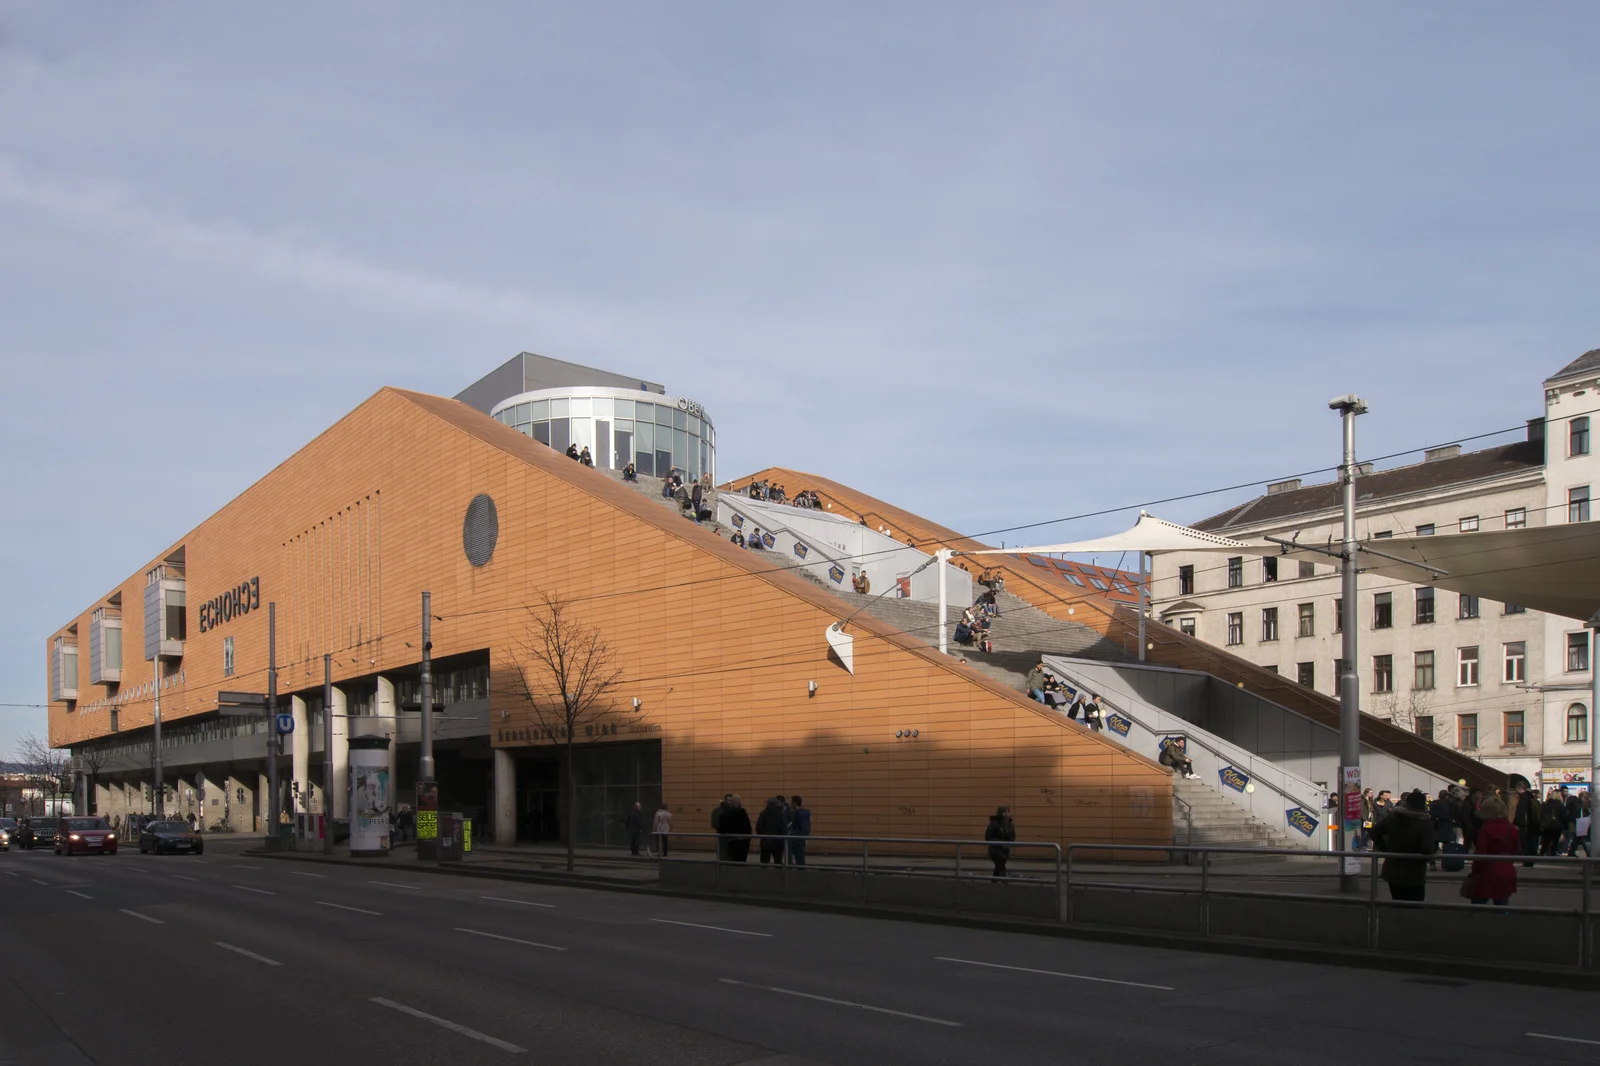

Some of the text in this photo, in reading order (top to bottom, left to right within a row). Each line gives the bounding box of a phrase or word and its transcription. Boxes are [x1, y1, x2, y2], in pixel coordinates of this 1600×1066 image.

[279, 718, 292, 731] U
[1109, 716, 1128, 731] Kino
[1223, 769, 1245, 786] Kino
[1290, 810, 1314, 830] Kino
